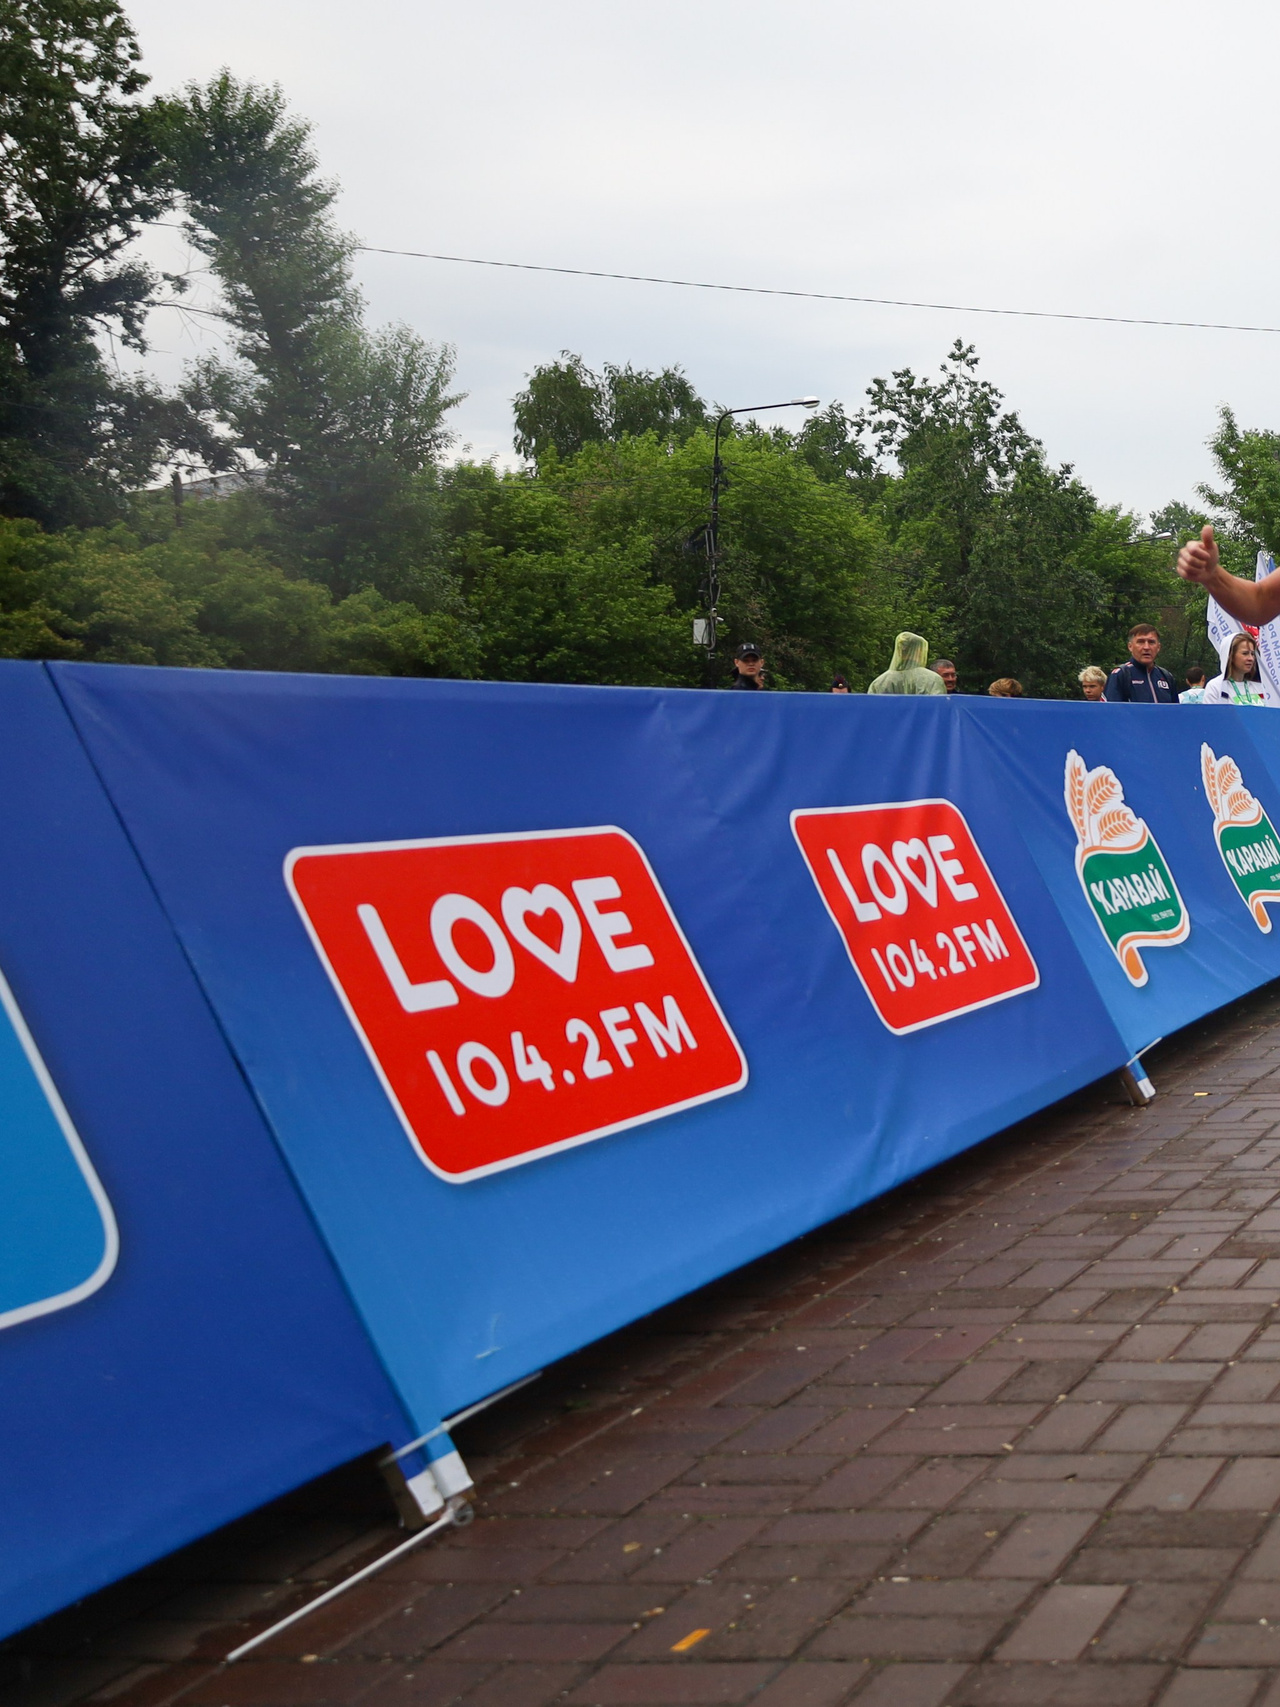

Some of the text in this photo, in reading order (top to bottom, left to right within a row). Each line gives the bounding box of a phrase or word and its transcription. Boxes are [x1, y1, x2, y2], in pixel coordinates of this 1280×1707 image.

[826, 834, 980, 923] LOVE
[1090, 863, 1171, 915] КАРАВАЙ
[356, 876, 655, 1013] LOVE
[871, 918, 1010, 992] 104.2FM
[426, 995, 698, 1116] 104.2FM
